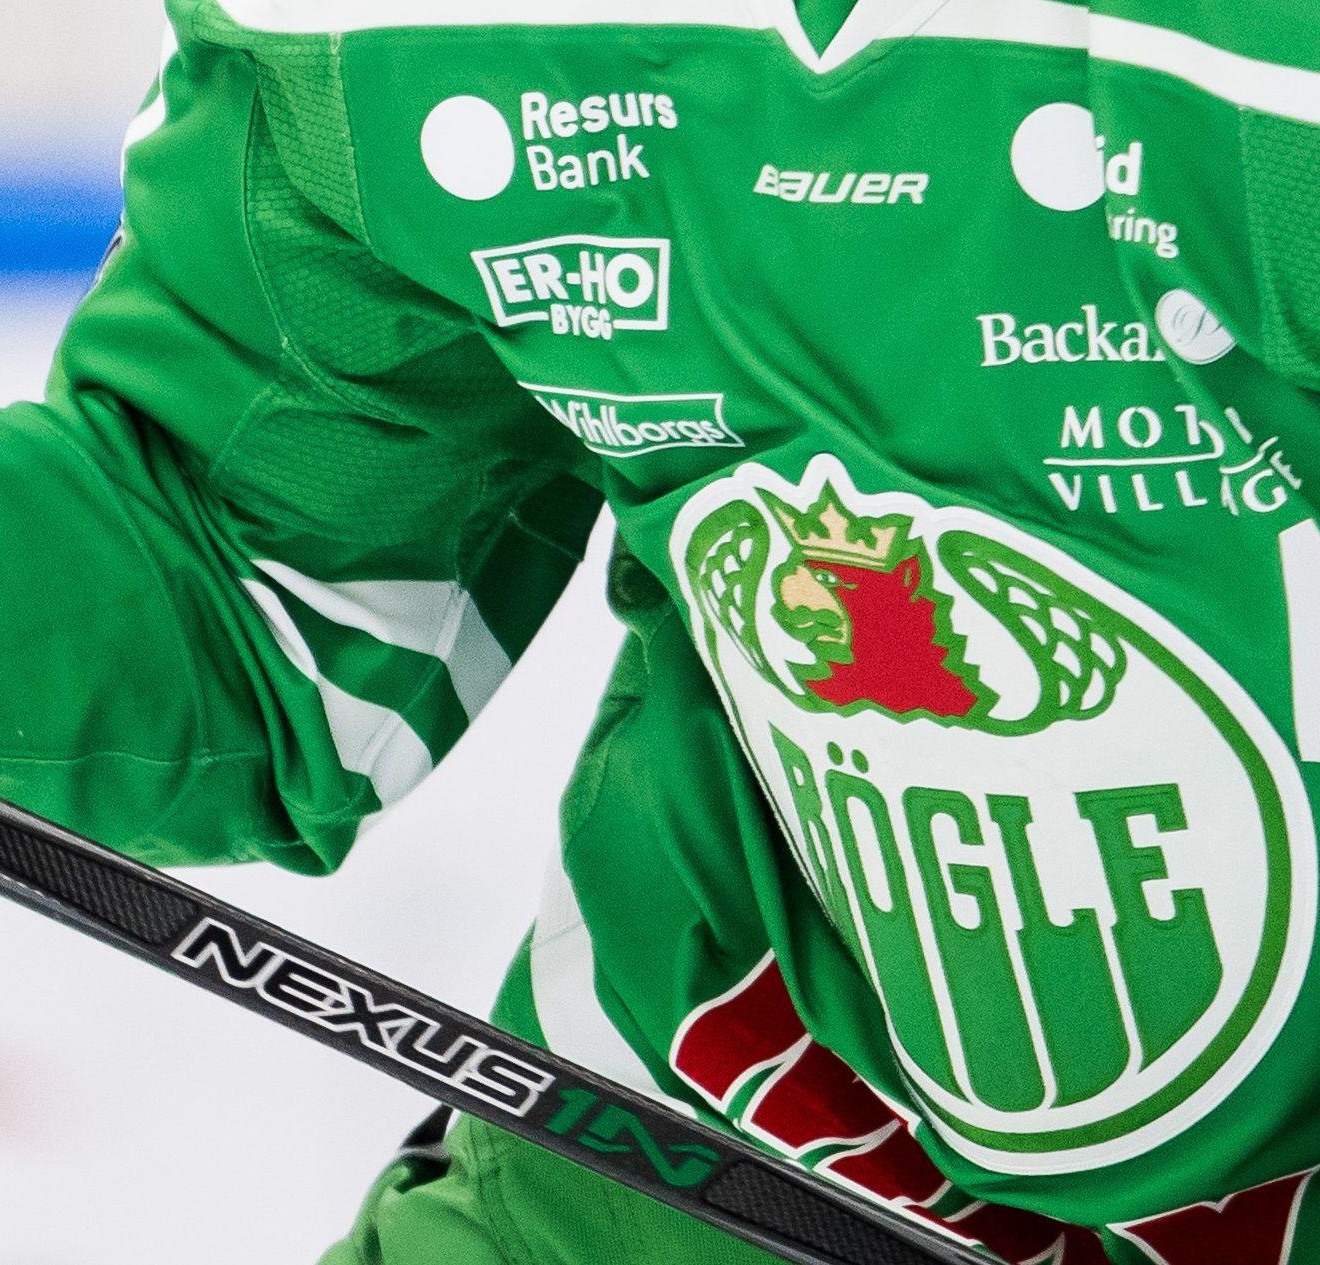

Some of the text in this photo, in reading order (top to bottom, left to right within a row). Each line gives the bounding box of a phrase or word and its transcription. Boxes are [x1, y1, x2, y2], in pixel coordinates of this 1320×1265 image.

[520, 91, 678, 142] Resurs
[525, 134, 650, 192] Bank
[1106, 207, 1179, 258] ring
[491, 252, 655, 308] ER-HO
[550, 304, 613, 340] BYGG
[975, 303, 1168, 367] Backa
[768, 720, 1213, 971] RÖGLE
[171, 916, 557, 1118] NEXUS
